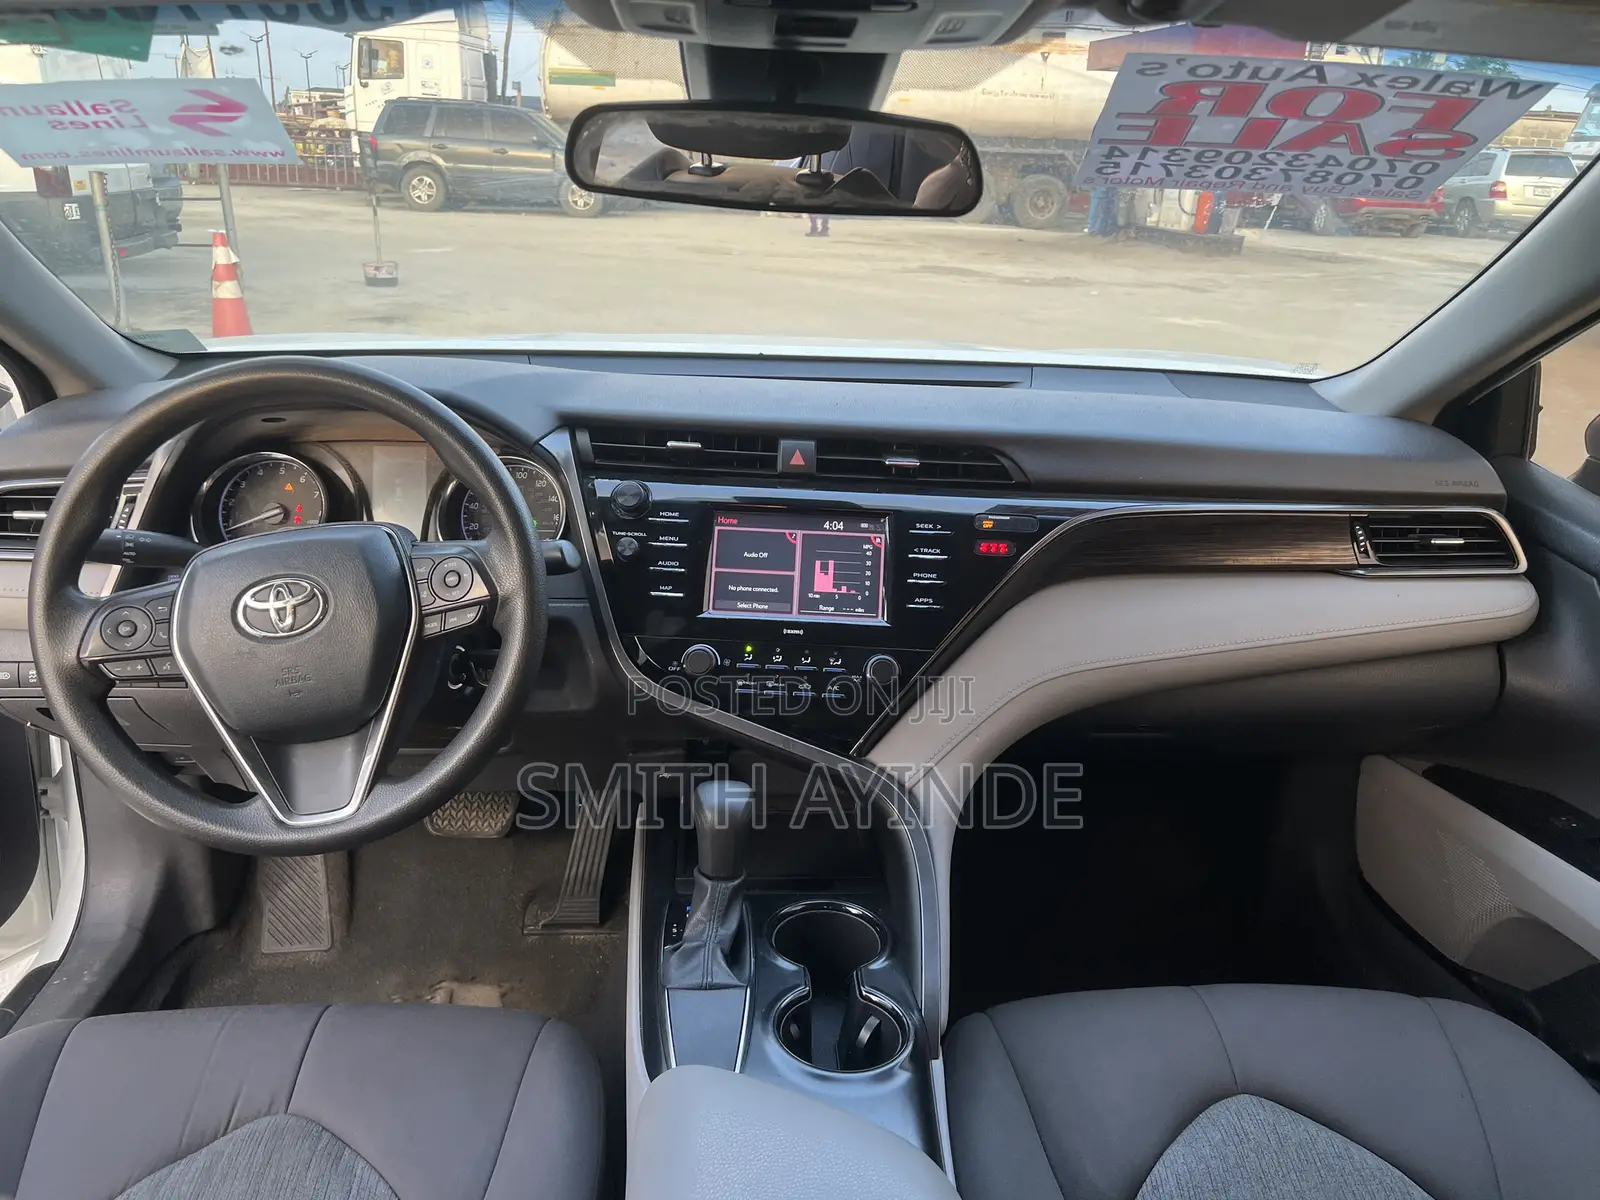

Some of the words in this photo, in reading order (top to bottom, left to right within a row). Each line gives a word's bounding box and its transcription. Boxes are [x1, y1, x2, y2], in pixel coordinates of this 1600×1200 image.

[280, 467, 285, 475] 5
[516, 471, 528, 479] 100
[313, 491, 320, 499] 7
[717, 516, 738, 525] Home
[823, 520, 844, 531] 4:04
[743, 551, 758, 559] Audio
[736, 585, 752, 593] phone
[737, 601, 752, 609] Select
[752, 602, 769, 610] Phone
[818, 604, 835, 612] Range
